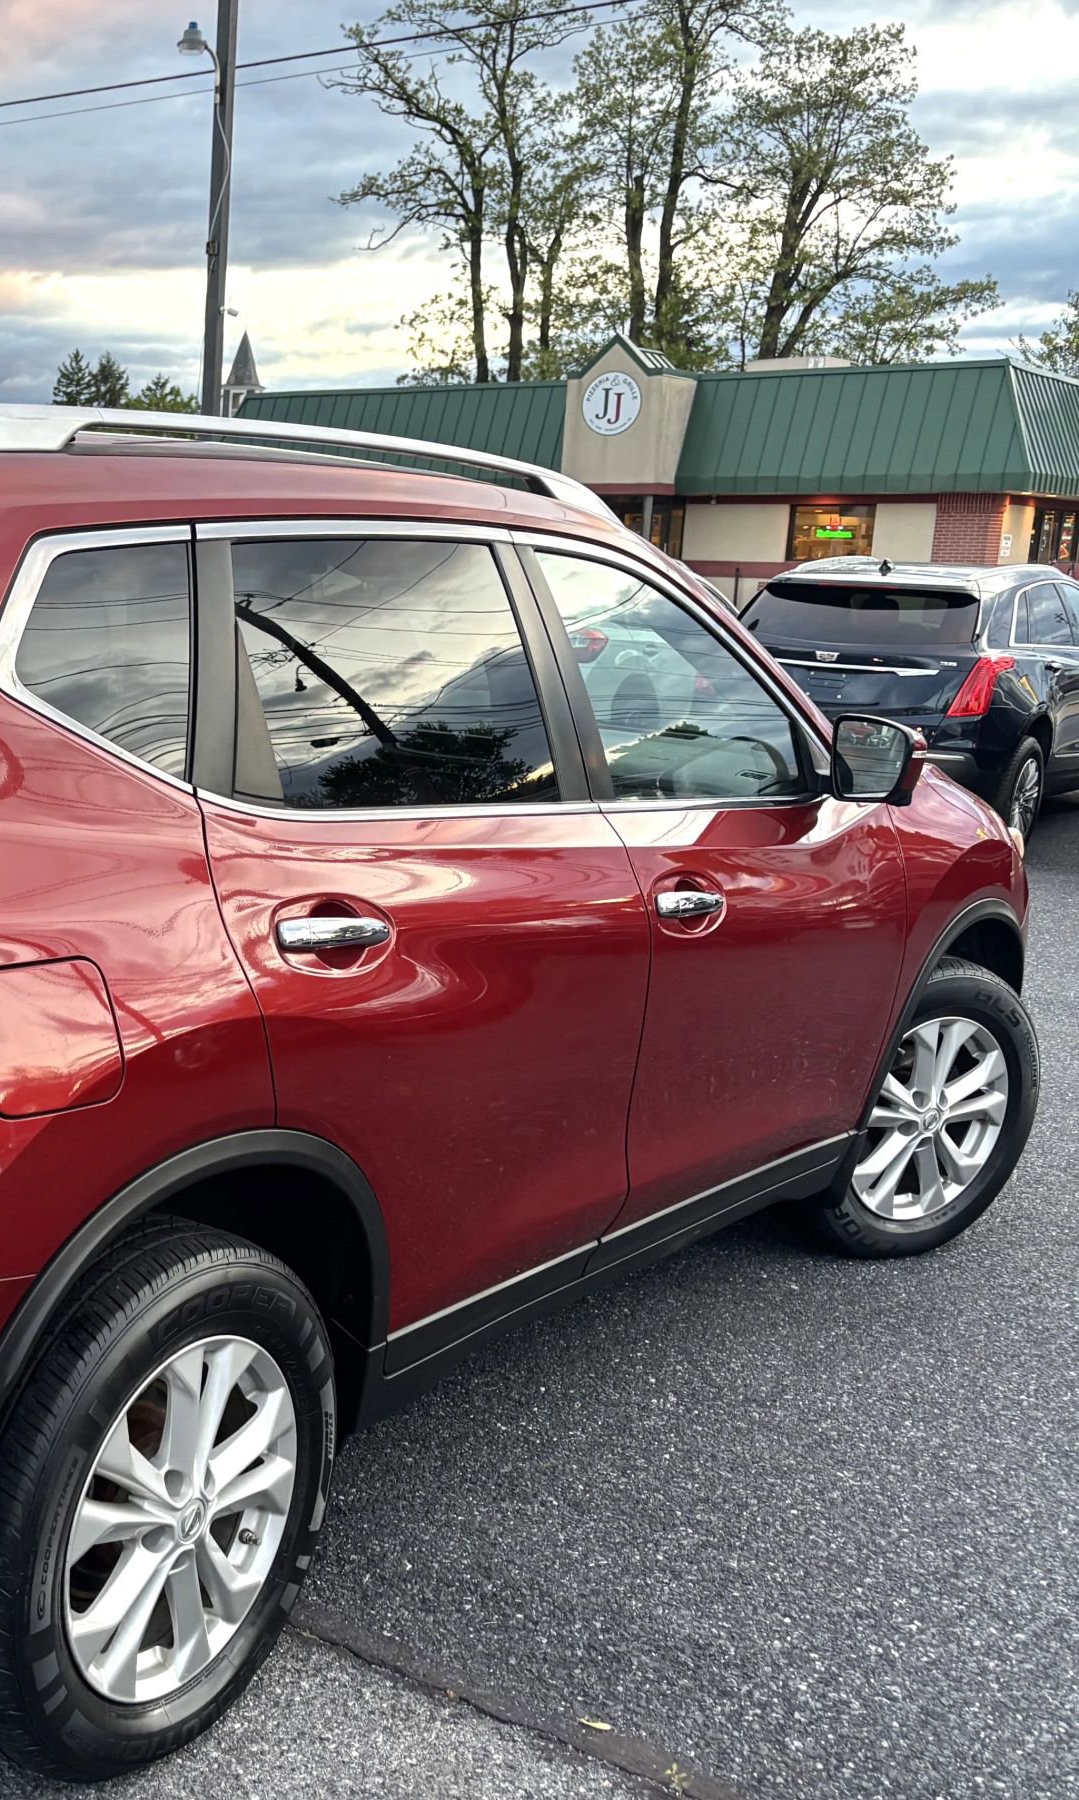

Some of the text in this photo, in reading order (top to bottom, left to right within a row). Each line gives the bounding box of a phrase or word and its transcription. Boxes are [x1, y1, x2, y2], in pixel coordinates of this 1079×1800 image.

[586, 374, 638, 402] PIZZERIA & GRILLE
[595, 387, 625, 425] JJ
[158, 1283, 297, 1343] COOPER
